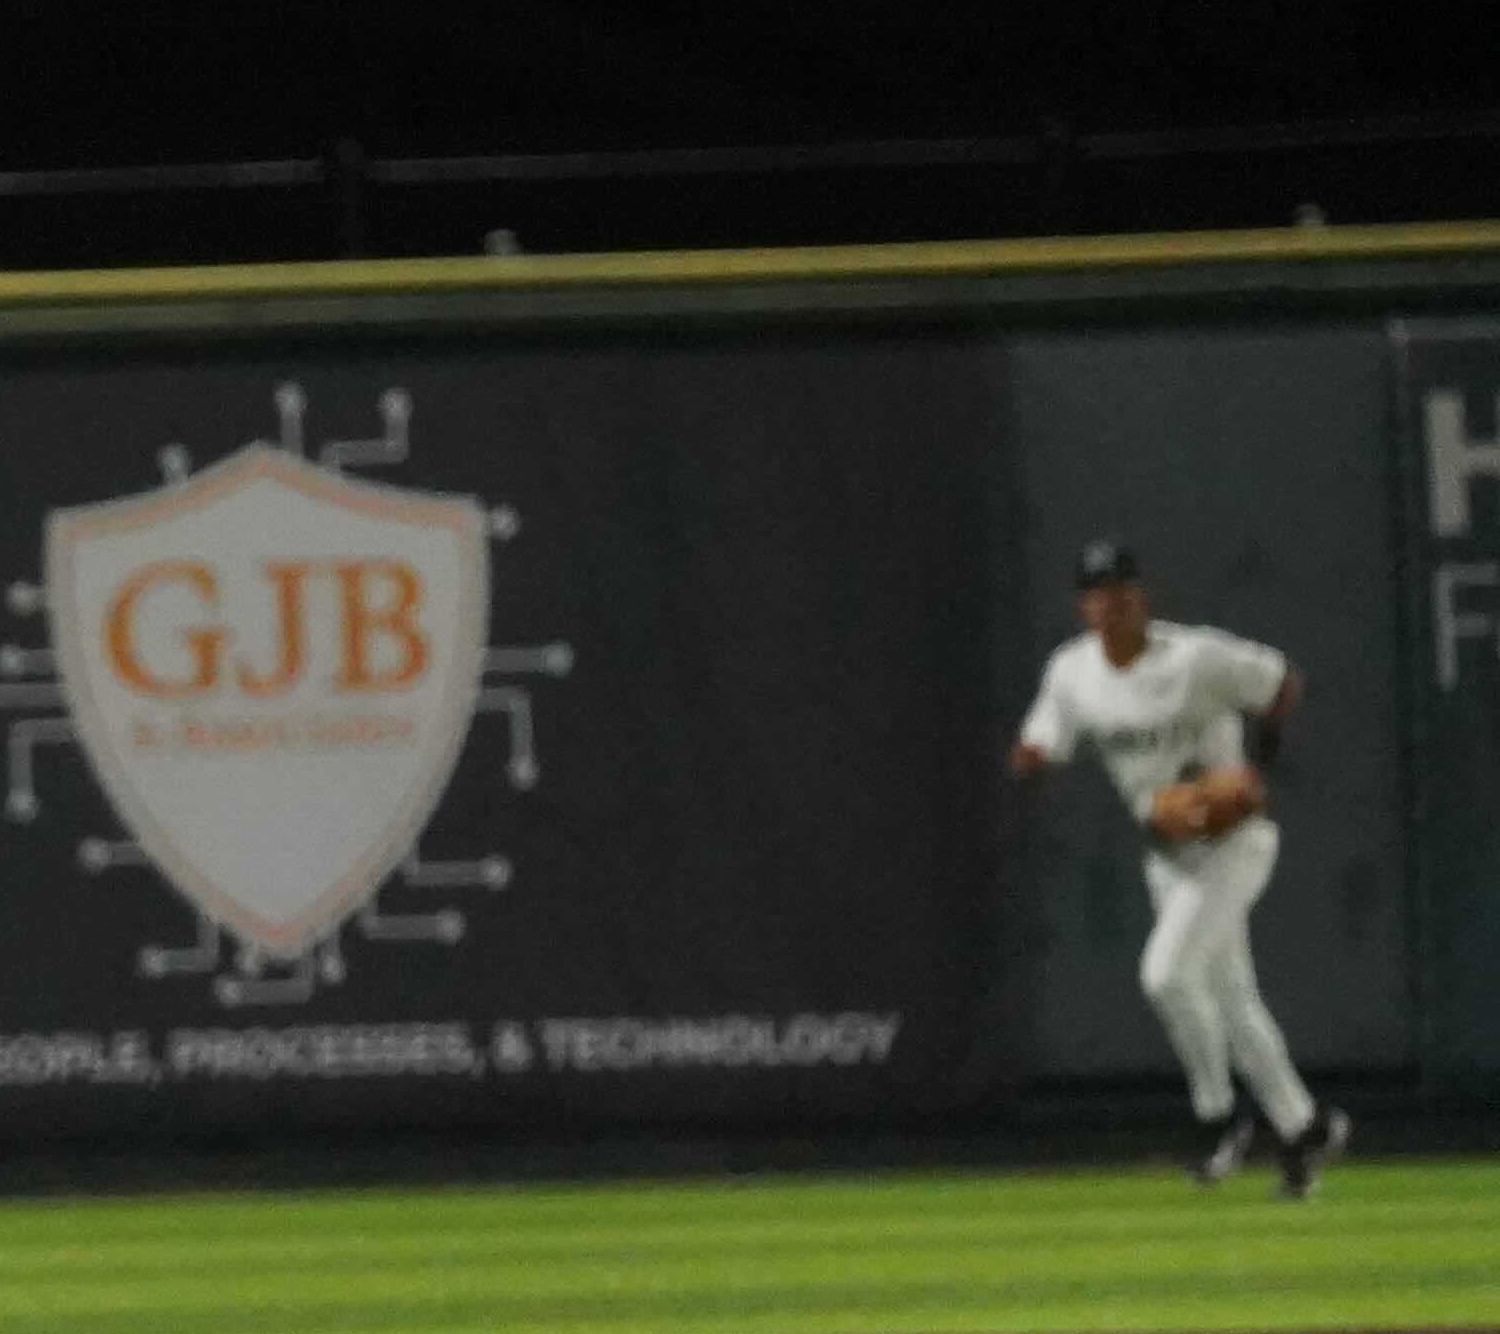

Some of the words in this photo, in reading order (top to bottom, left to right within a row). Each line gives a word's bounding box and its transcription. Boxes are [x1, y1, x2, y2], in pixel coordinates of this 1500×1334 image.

[103, 556, 432, 704] GJB
[1434, 564, 1500, 691] F
[166, 1020, 485, 1081] PROCESSES,
[536, 1011, 901, 1073] TECHNOLOGY
